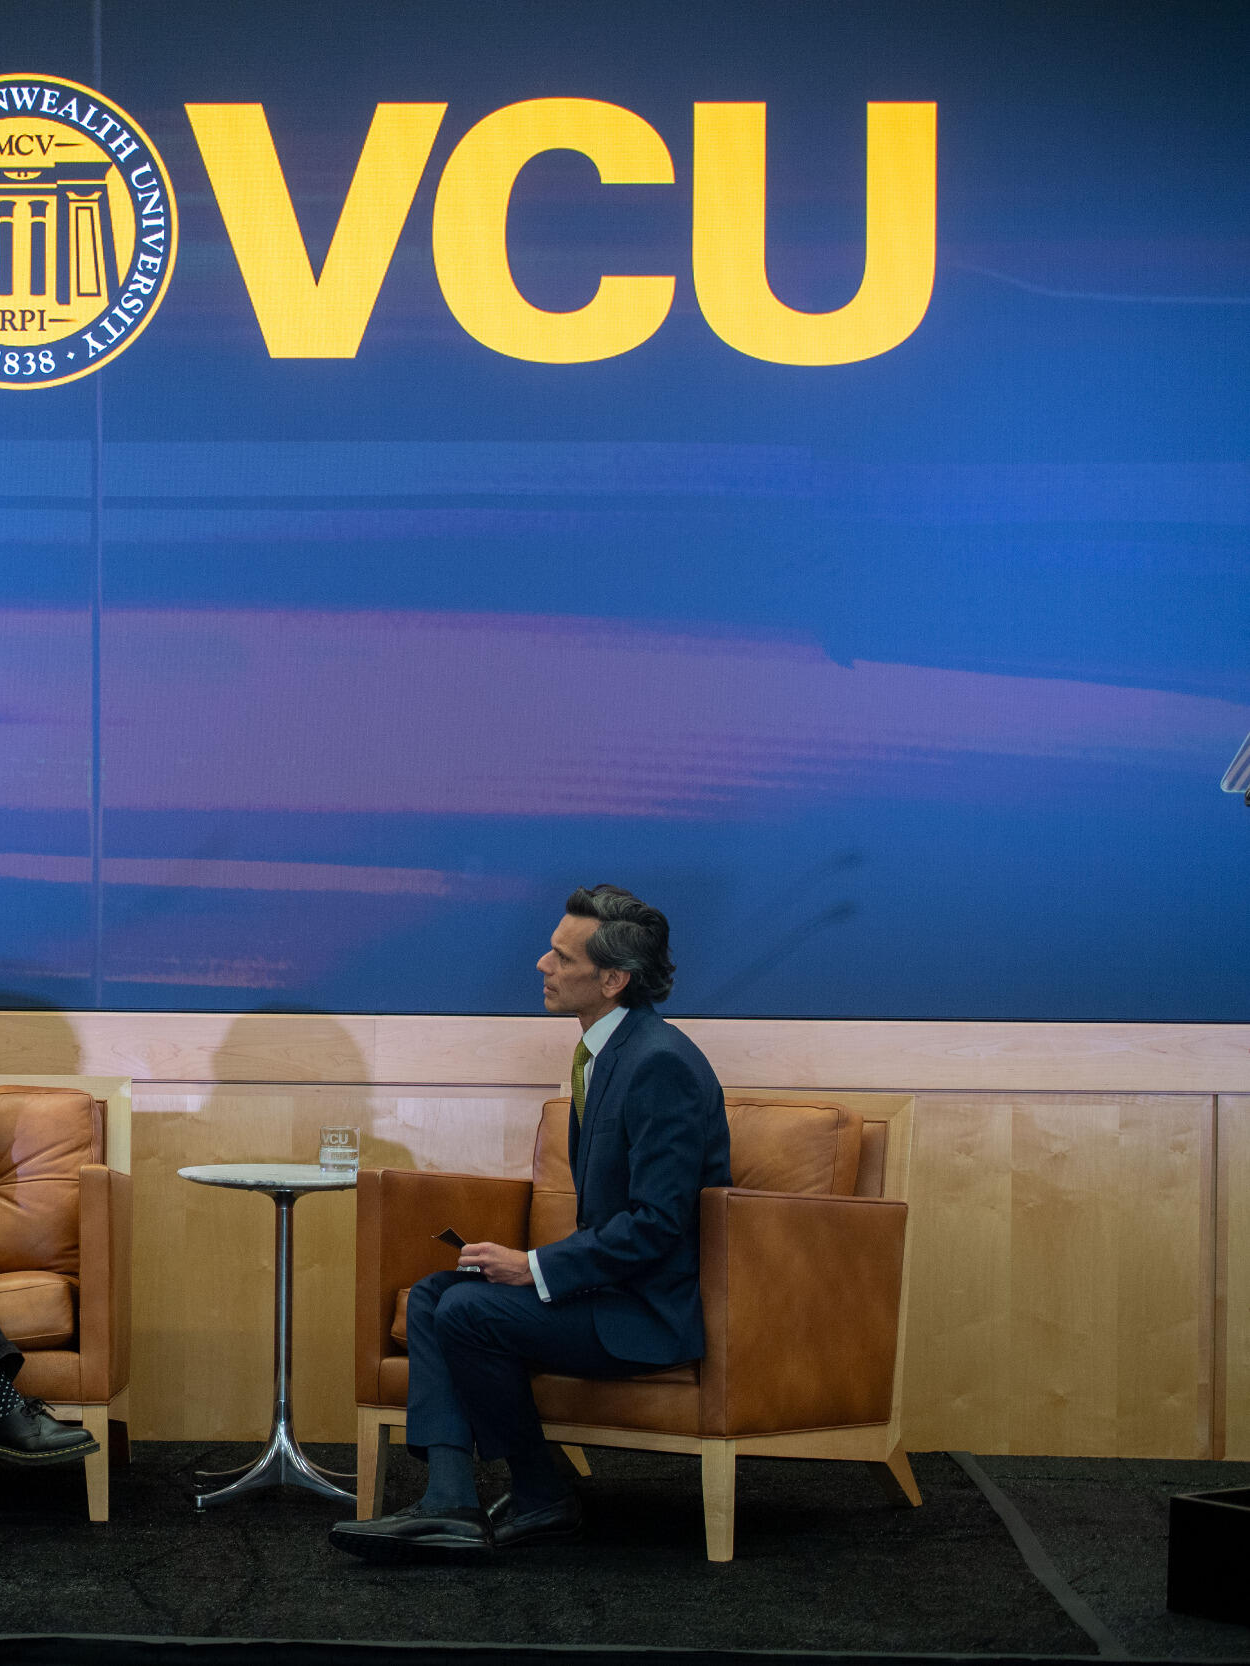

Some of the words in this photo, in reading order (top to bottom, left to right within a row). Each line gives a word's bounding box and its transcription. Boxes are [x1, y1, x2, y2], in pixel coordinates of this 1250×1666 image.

[81, 162, 165, 358] UNIVERSITY
[184, 97, 938, 367] VCU
[0, 309, 47, 332] RPI
[321, 1132, 349, 1145] VCU
